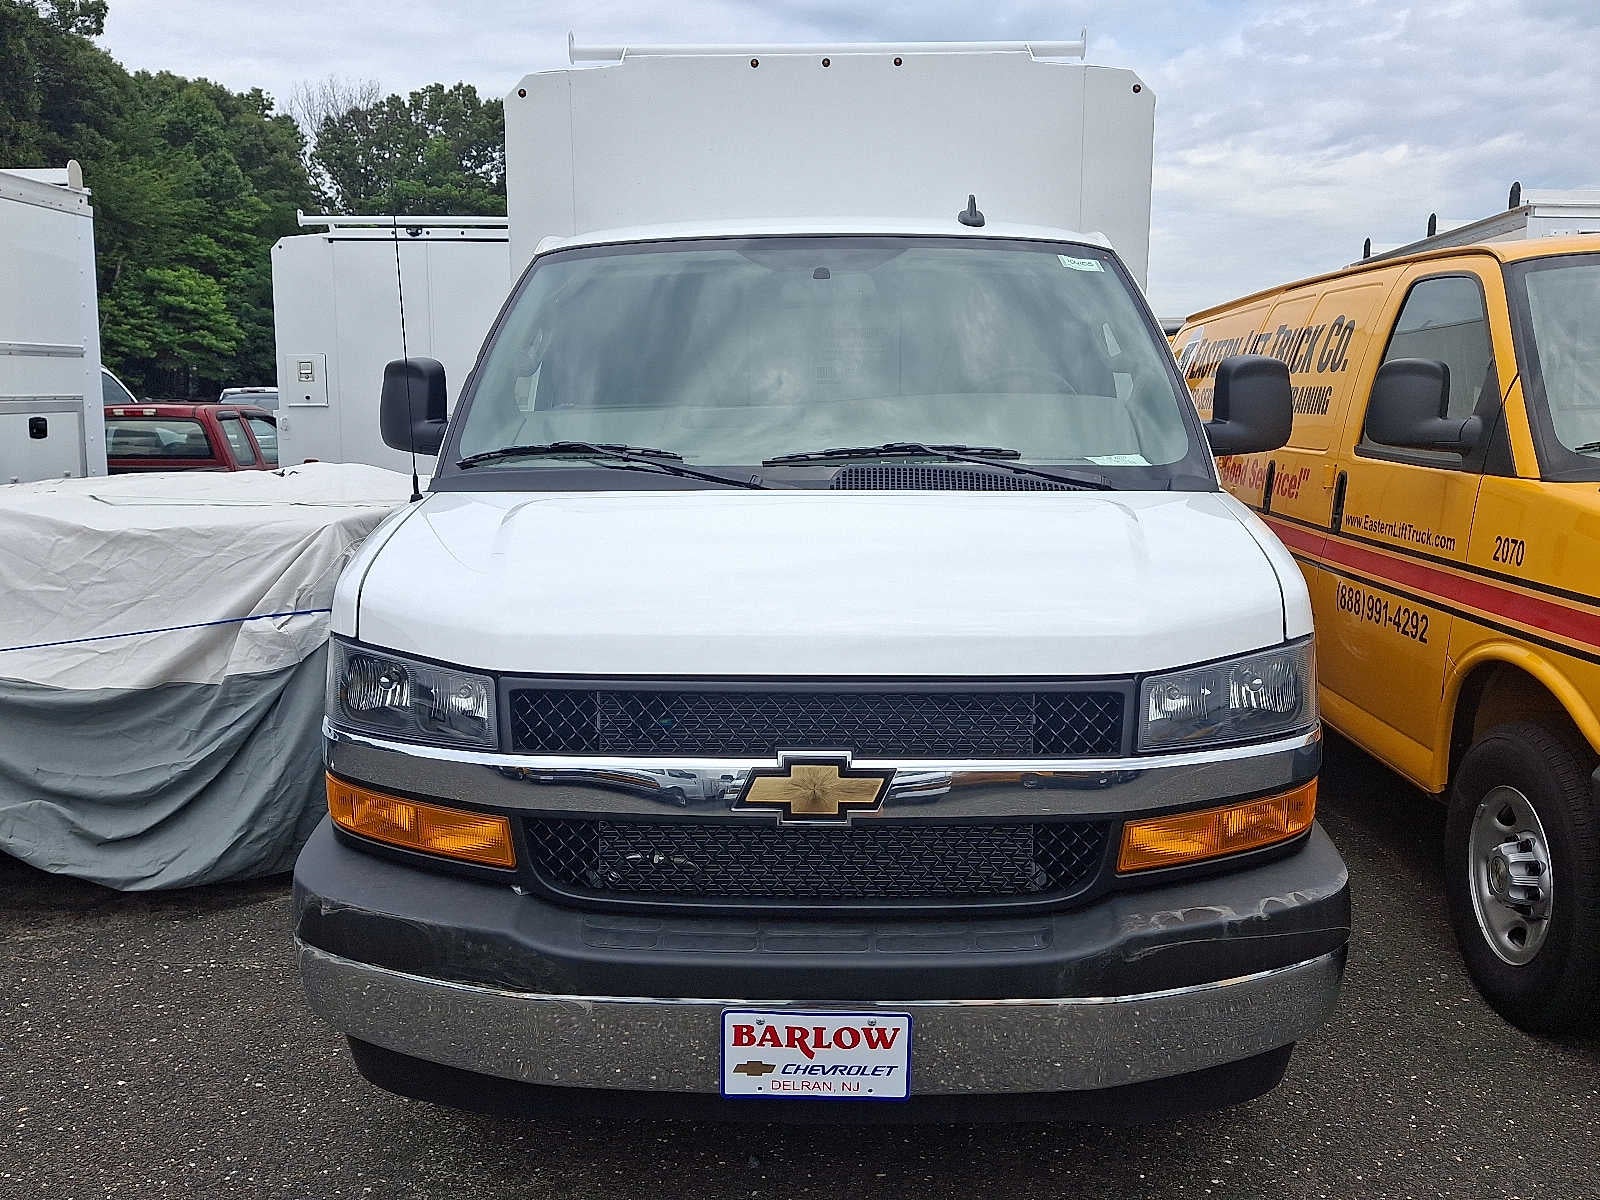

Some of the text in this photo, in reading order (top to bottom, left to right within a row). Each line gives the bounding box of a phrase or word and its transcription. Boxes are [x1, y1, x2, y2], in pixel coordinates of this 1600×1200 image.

[1269, 324, 1327, 374] TRUCK
[1316, 314, 1356, 373] CO.
[1291, 386, 1333, 415] RAINING
[1345, 513, 1456, 552] www.EasternLiftTruck.com
[1492, 535, 1525, 567] 2070
[731, 1024, 901, 1060] BARLOW
[771, 1079, 860, 1093] DELRAN, NJ
[781, 1063, 898, 1077] CHEVROLET
